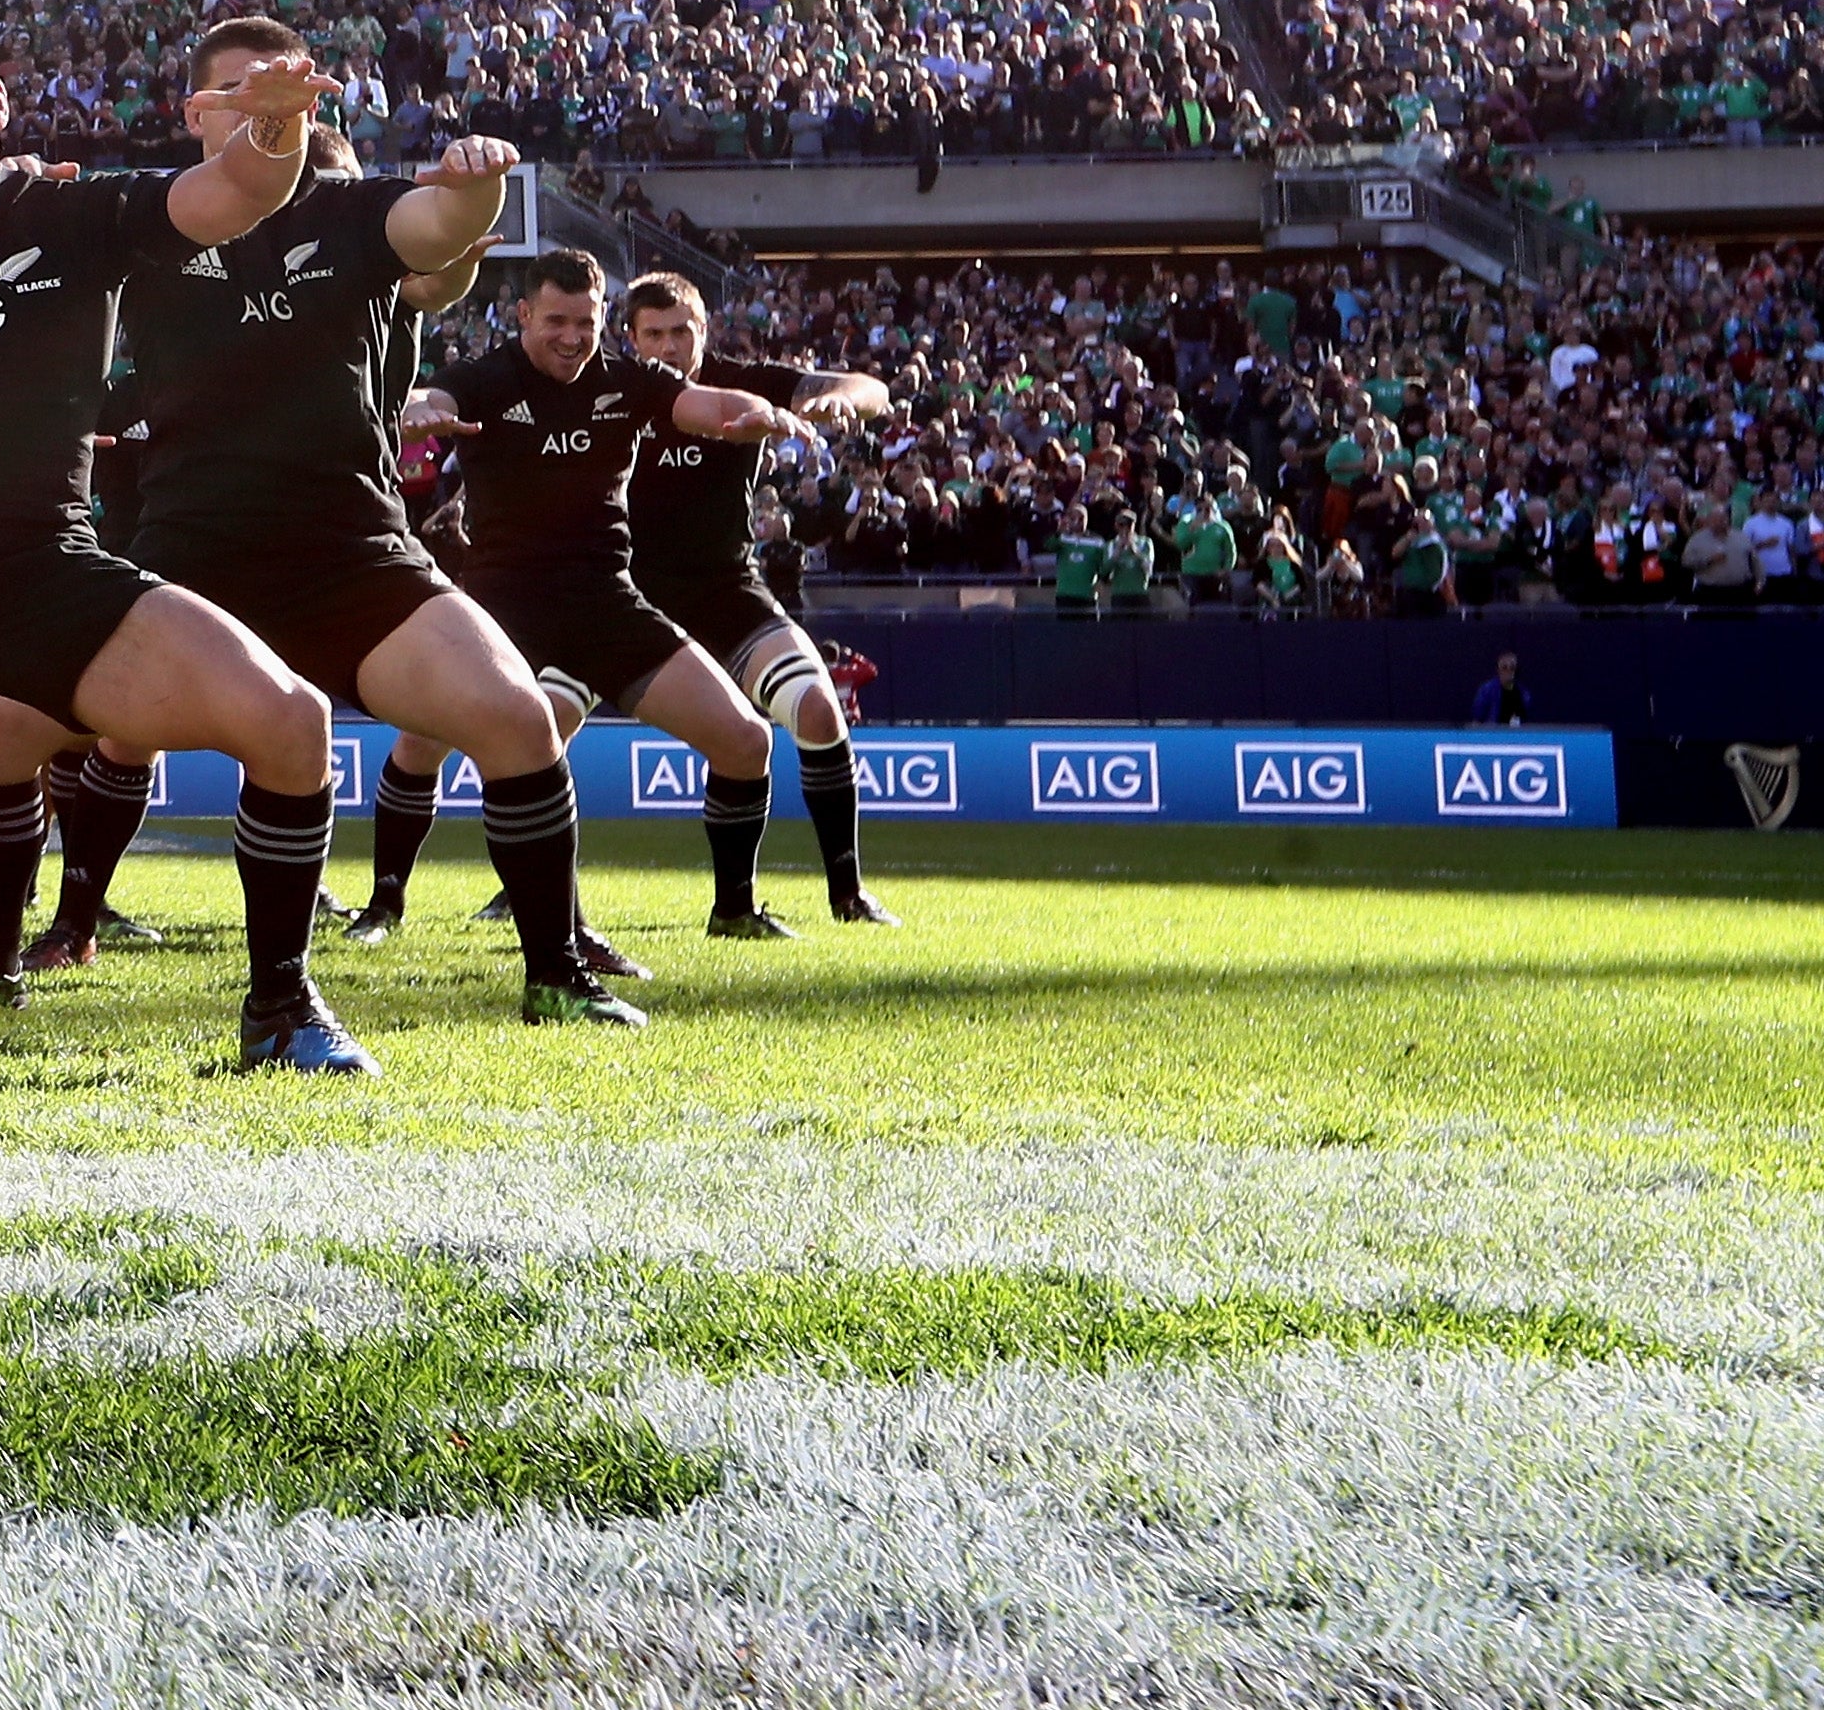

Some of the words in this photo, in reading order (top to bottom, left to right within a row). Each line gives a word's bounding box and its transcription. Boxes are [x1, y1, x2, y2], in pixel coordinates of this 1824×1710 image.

[1364, 189, 1410, 212] 125
[16, 277, 61, 293] BLACKS
[181, 262, 228, 281] adidas
[240, 291, 293, 324] AIG
[541, 430, 592, 455] AIG
[658, 445, 703, 467] AIG
[649, 755, 710, 796] AI
[854, 755, 940, 797] AIG
[1047, 756, 1143, 799] AIG
[1252, 757, 1348, 801] AIG
[1452, 758, 1549, 802] AIG
